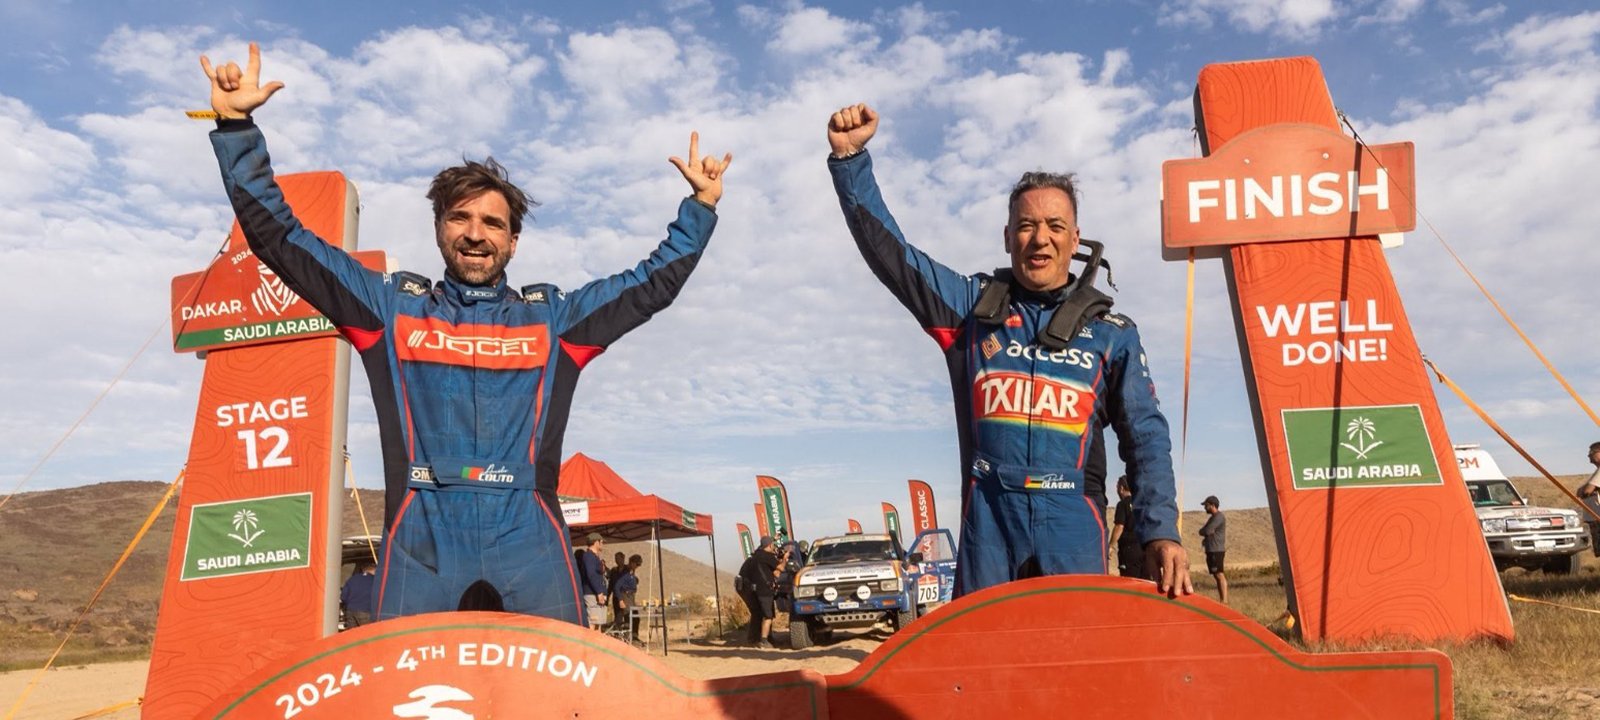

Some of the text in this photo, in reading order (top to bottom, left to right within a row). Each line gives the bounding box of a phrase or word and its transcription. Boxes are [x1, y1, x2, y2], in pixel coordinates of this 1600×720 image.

[1187, 167, 1390, 223] FINISH
[181, 299, 242, 321] DAKAR
[1256, 298, 1394, 337] WELL
[224, 317, 336, 342] SAUDI ARABIA
[425, 329, 537, 356] JOCEL
[1006, 340, 1095, 369] access
[1282, 338, 1388, 366] DONE!
[216, 396, 308, 427] STAGE
[981, 377, 1079, 419] TXILAR
[237, 426, 292, 470] 12
[411, 470, 433, 480] OM
[1302, 463, 1422, 480] SAUDI ARABIA
[918, 489, 929, 529] CLASSIC
[197, 547, 301, 571] SAUDI ARABIA
[919, 586, 938, 601] 705
[275, 665, 362, 719] 2024
[396, 643, 446, 671] 4TH
[458, 642, 599, 688] EDITION
